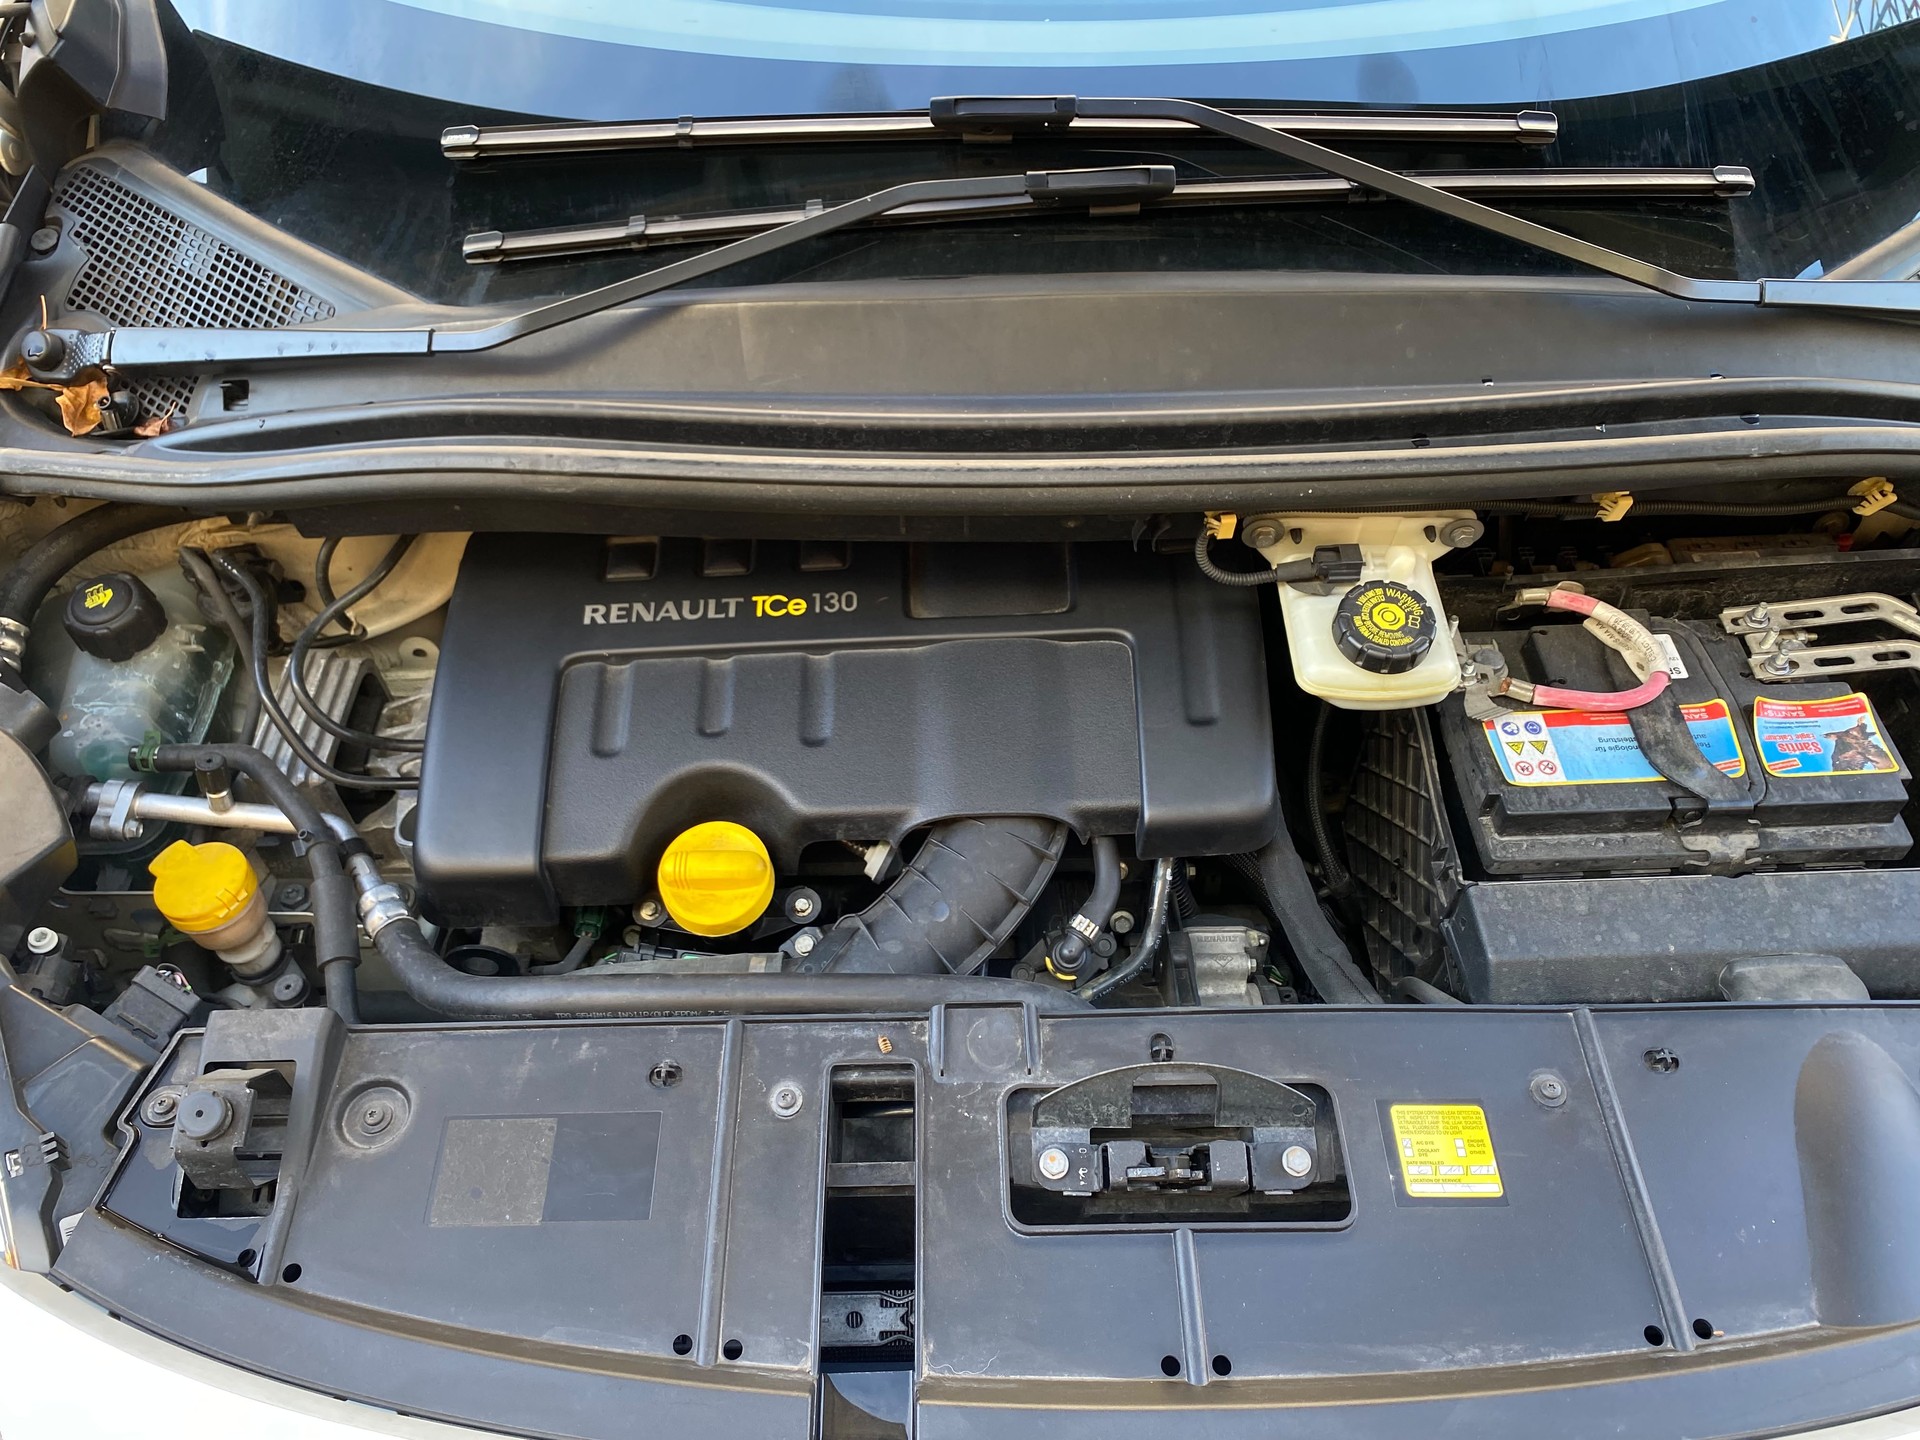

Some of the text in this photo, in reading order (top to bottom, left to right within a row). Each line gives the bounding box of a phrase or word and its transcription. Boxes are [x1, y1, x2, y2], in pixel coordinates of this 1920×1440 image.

[583, 590, 858, 625] RENAULT TCe 130
[1386, 588, 1424, 615] WARNING
[1398, 600, 1412, 612] SEE
[1595, 745, 1606, 753] für
[1608, 743, 1638, 753] nologie
[1777, 742, 1822, 754] Säntis
[1196, 935, 1239, 943] RENAULT
